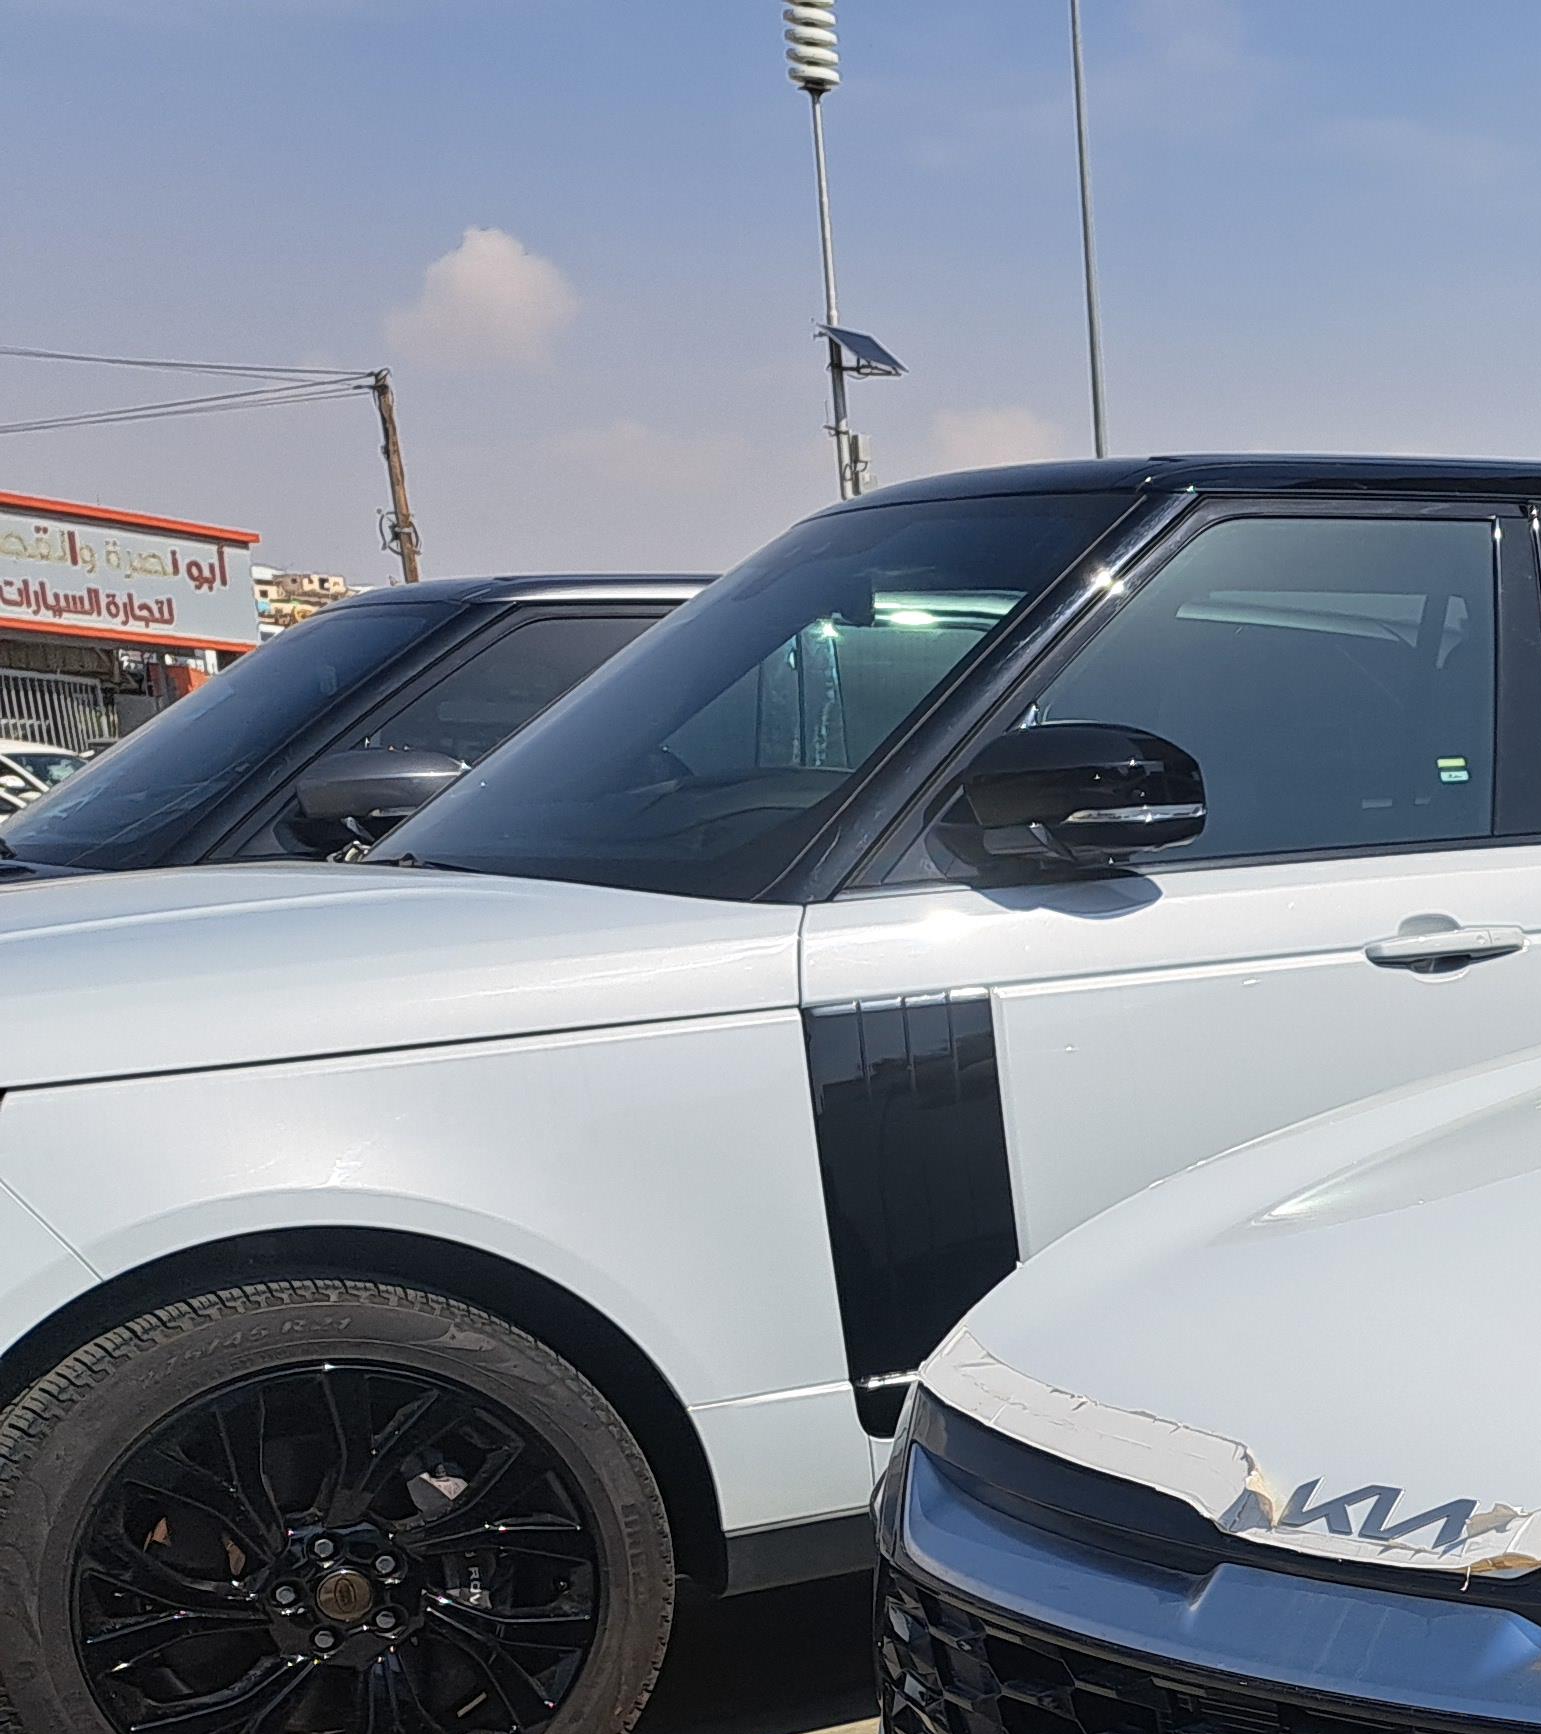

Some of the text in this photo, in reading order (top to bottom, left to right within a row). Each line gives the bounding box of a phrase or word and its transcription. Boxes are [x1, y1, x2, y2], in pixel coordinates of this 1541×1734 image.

[0, 578, 175, 628] لتجارة السيارات
[1279, 1475, 1481, 1549] KIA
